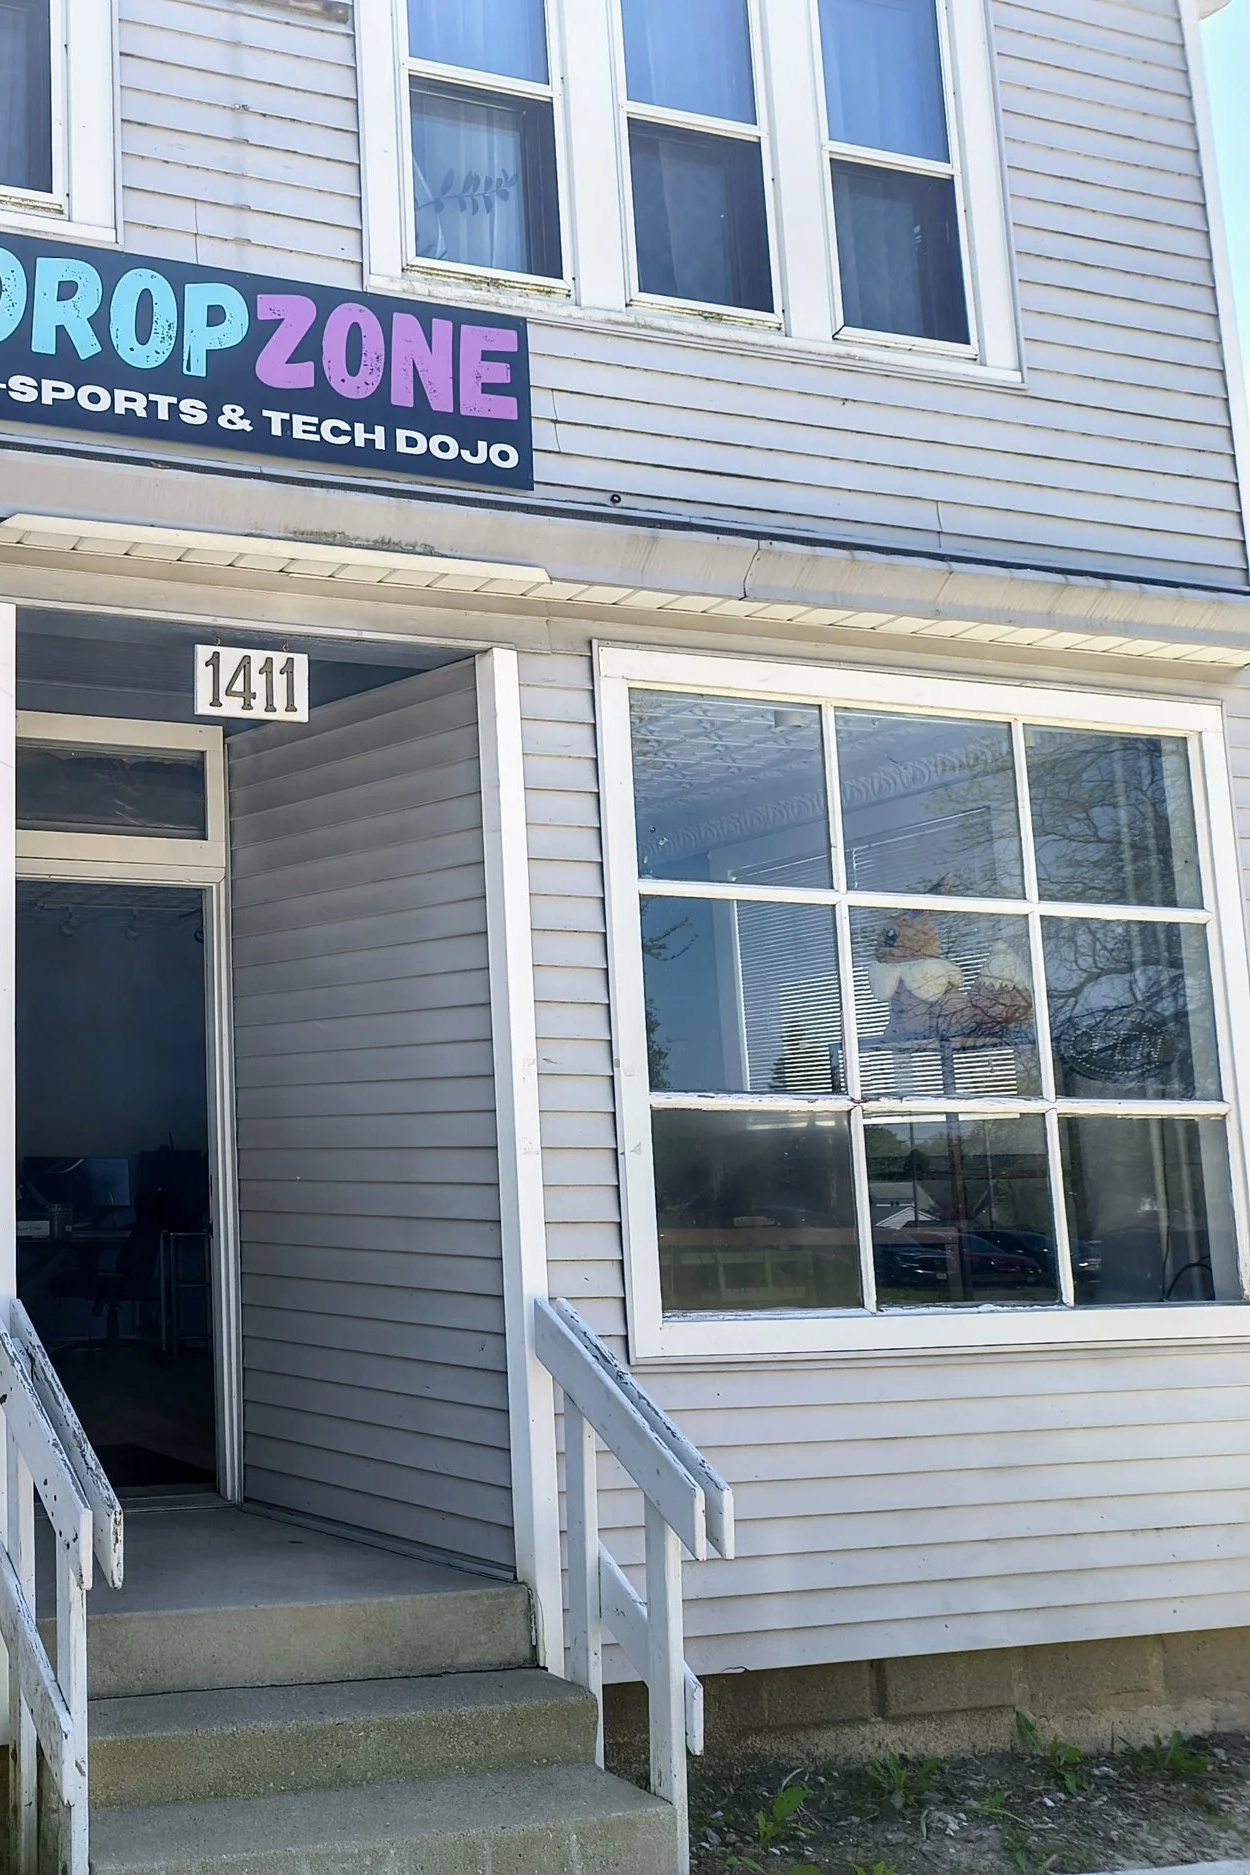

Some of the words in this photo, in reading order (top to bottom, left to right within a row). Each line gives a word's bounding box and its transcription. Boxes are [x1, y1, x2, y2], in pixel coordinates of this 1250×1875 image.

[217, 404, 254, 433] &
[262, 410, 387, 452] TECH
[396, 428, 520, 469] DOJO
[204, 651, 298, 713] 1411
